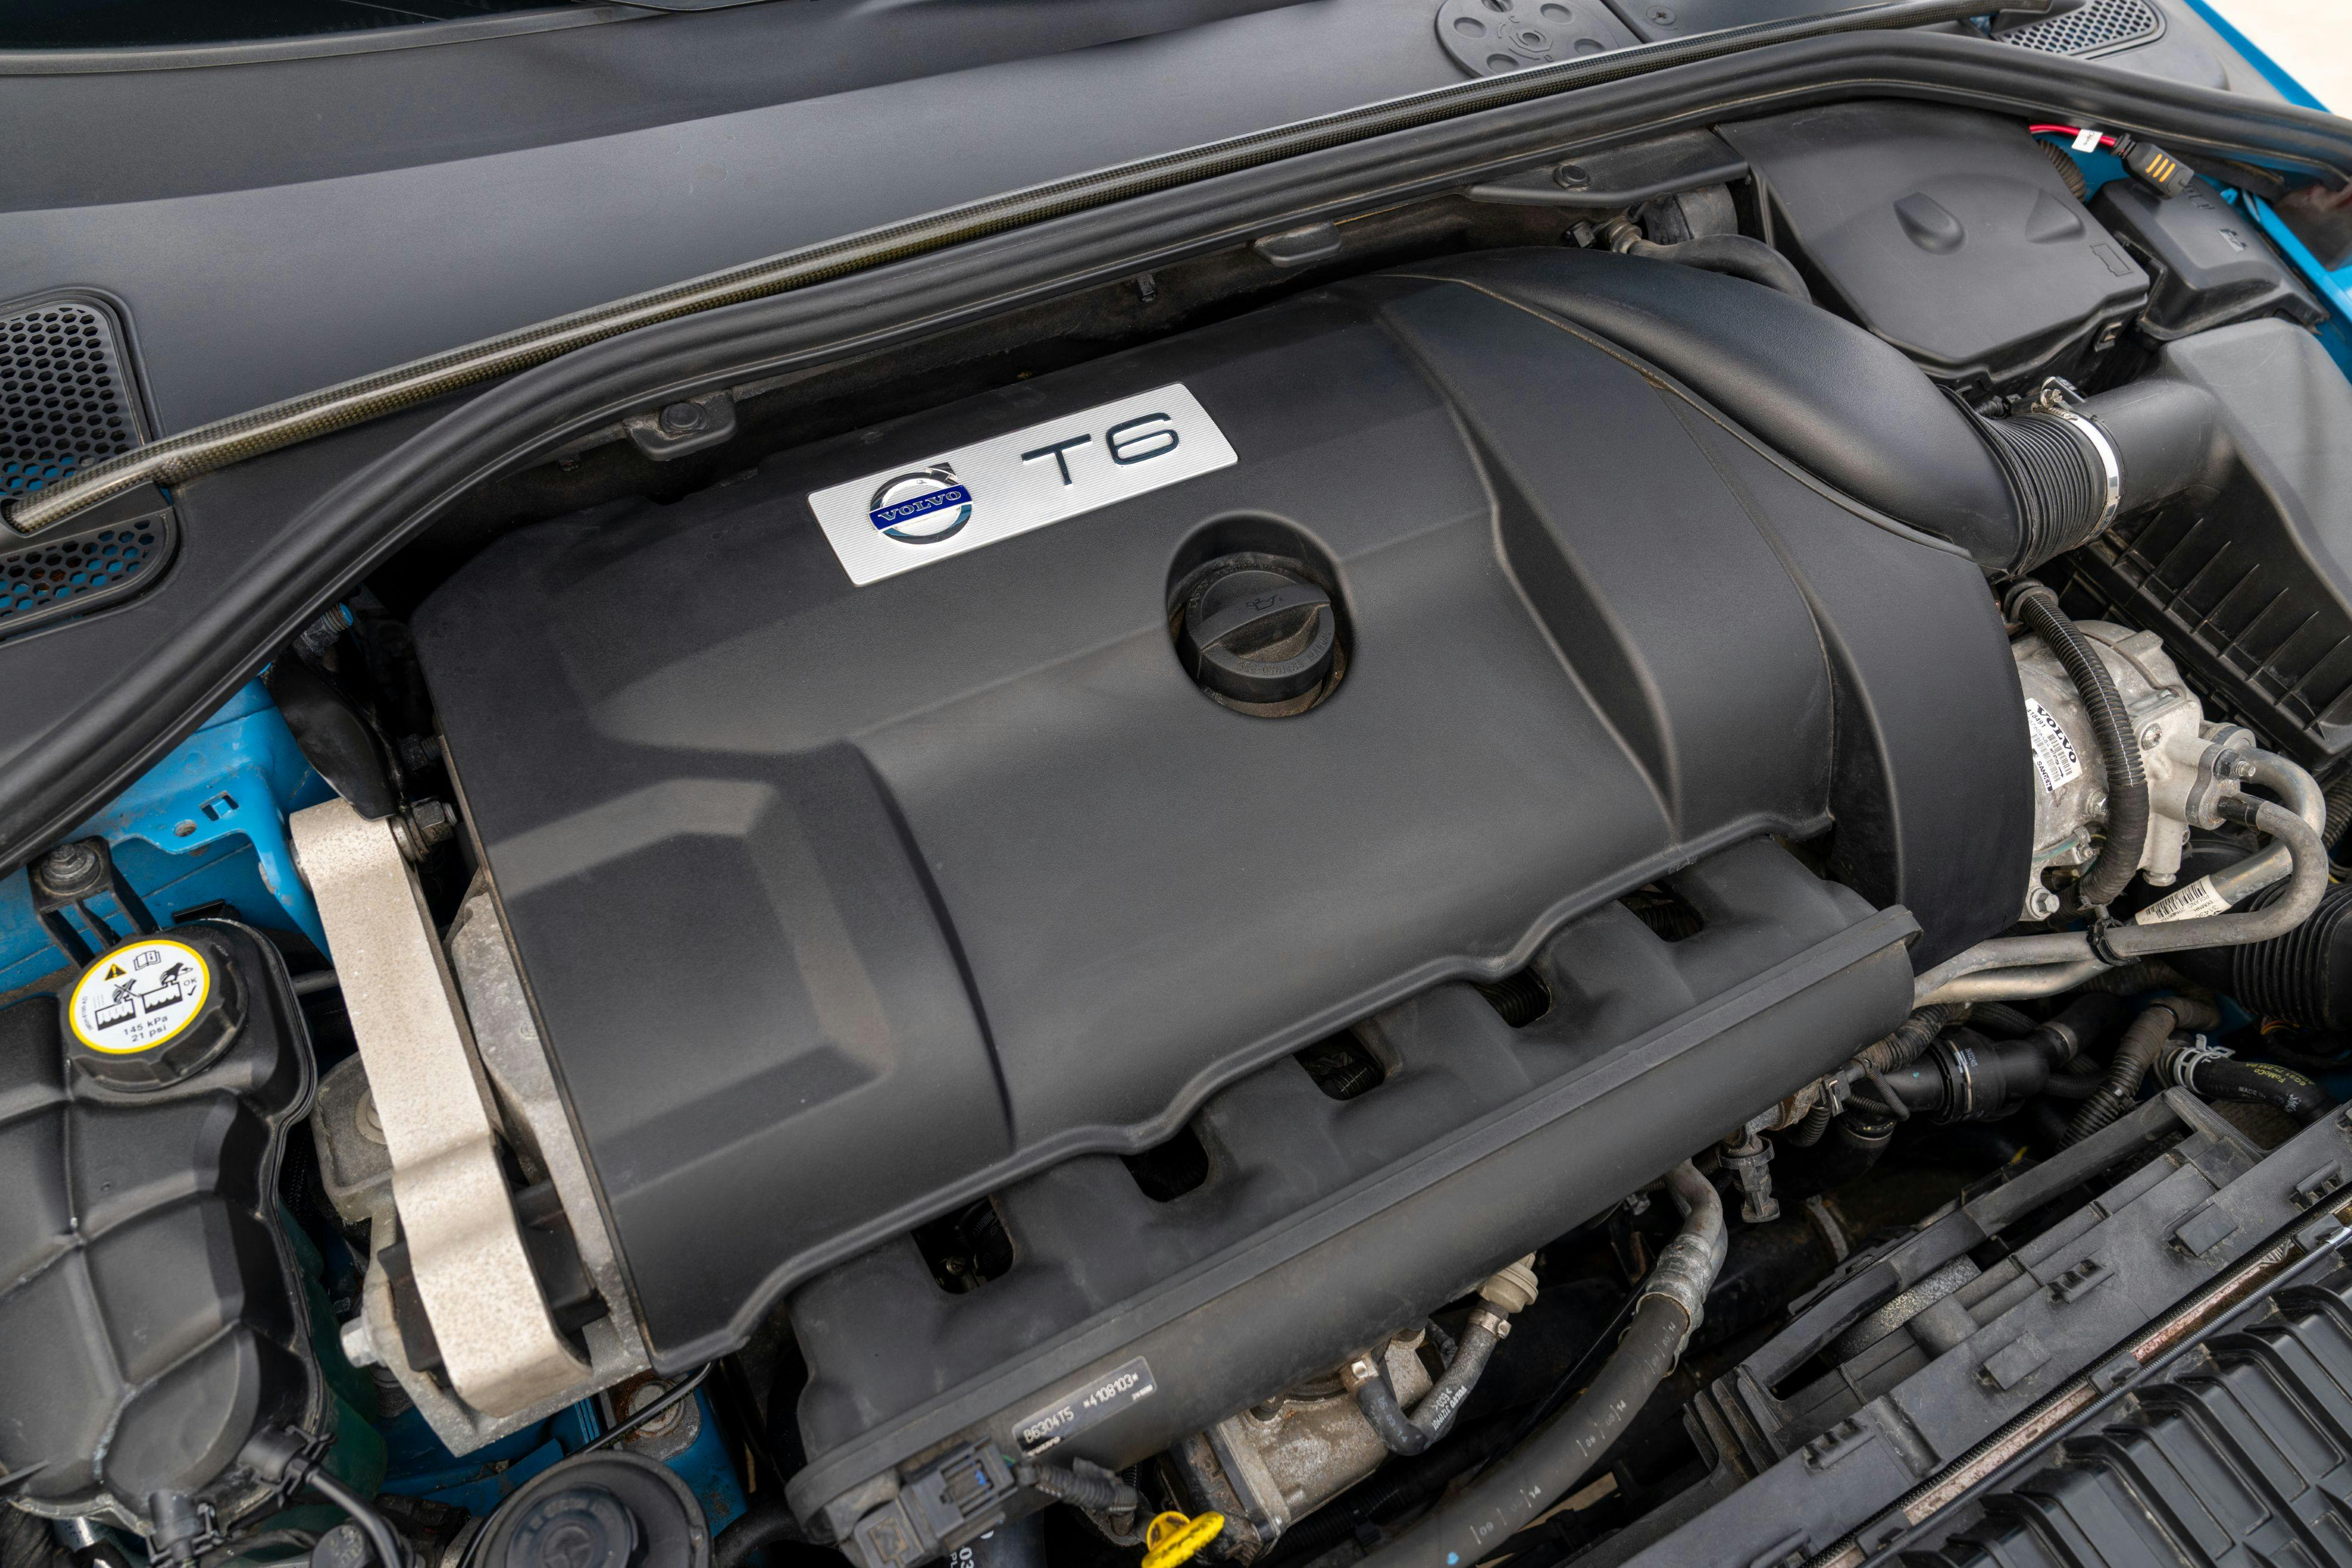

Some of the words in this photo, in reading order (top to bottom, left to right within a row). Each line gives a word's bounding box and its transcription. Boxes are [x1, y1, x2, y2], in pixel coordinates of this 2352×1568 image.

[1020, 412, 1180, 489] T6
[877, 491, 961, 521] VOLVO
[2026, 707, 2046, 728] 418491
[2037, 704, 2077, 763] VOLVO
[2037, 761, 2052, 787] SANDEN
[2187, 894, 2210, 908] POLAND
[183, 977, 198, 987] OK
[123, 1024, 143, 1035] 145
[147, 1015, 168, 1027] kPa
[132, 1034, 145, 1042] 21
[149, 1025, 167, 1038] psi
[2254, 1068, 2286, 1084] FoMoCo
[1449, 1385, 1468, 1409] VOLVO
